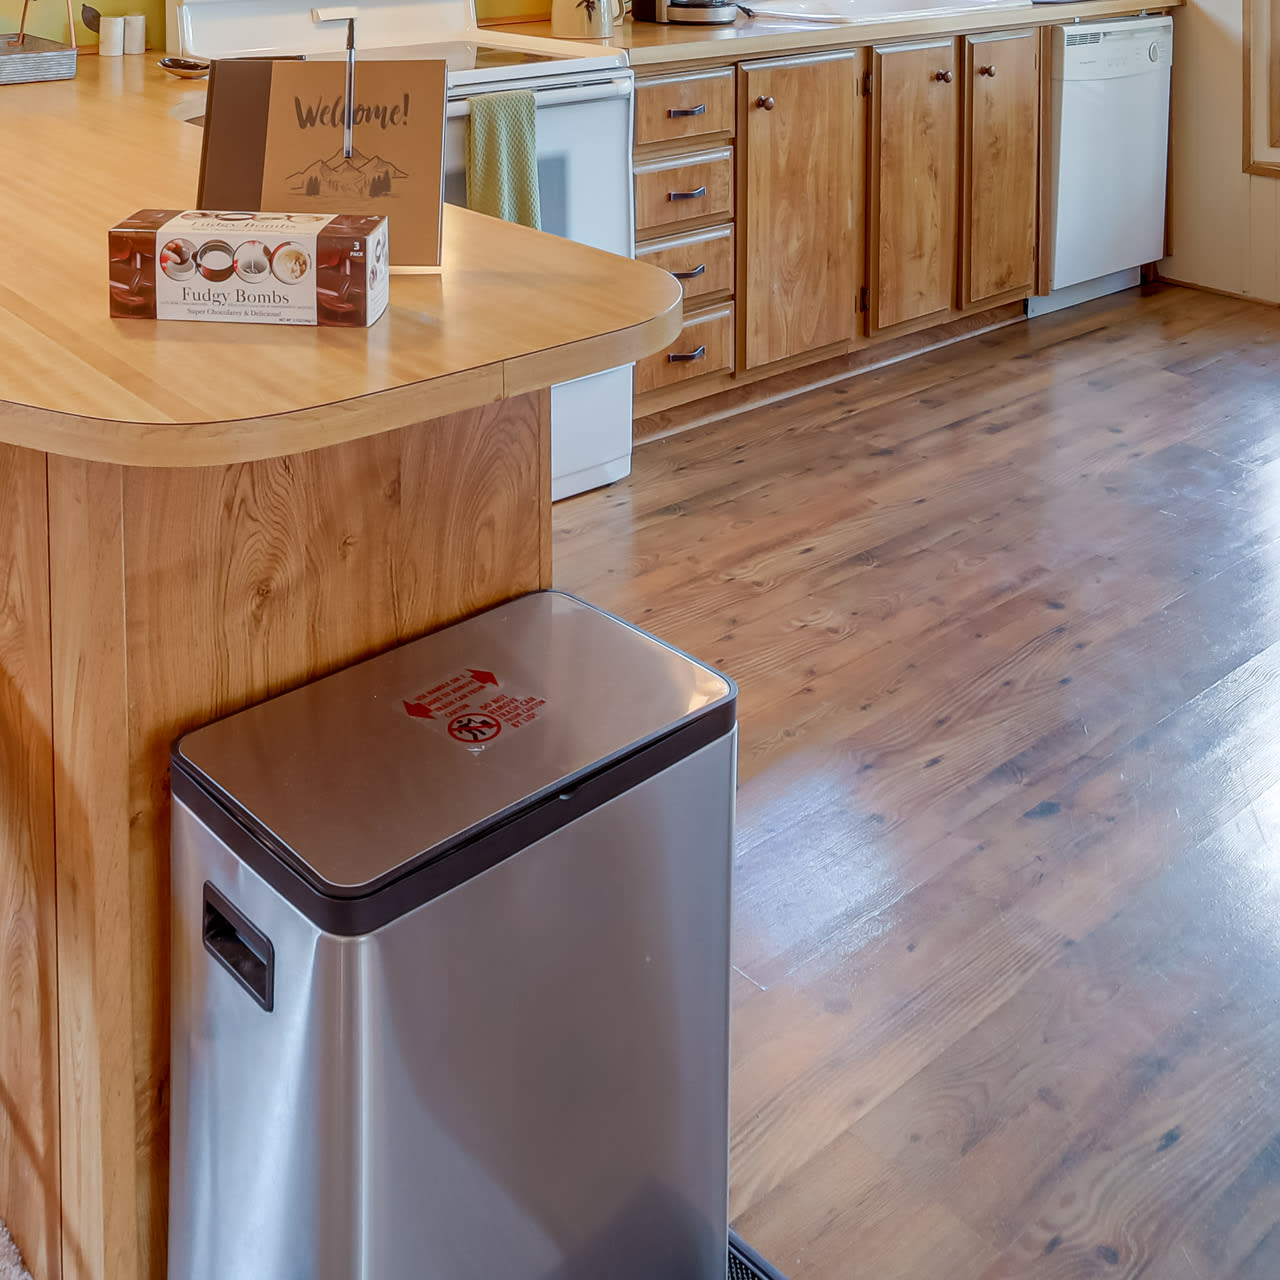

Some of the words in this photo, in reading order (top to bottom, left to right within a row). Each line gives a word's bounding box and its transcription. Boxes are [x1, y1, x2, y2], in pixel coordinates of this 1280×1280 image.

[353, 241, 360, 250] 3
[182, 287, 231, 306] Fudgy
[236, 289, 289, 304] Bombs
